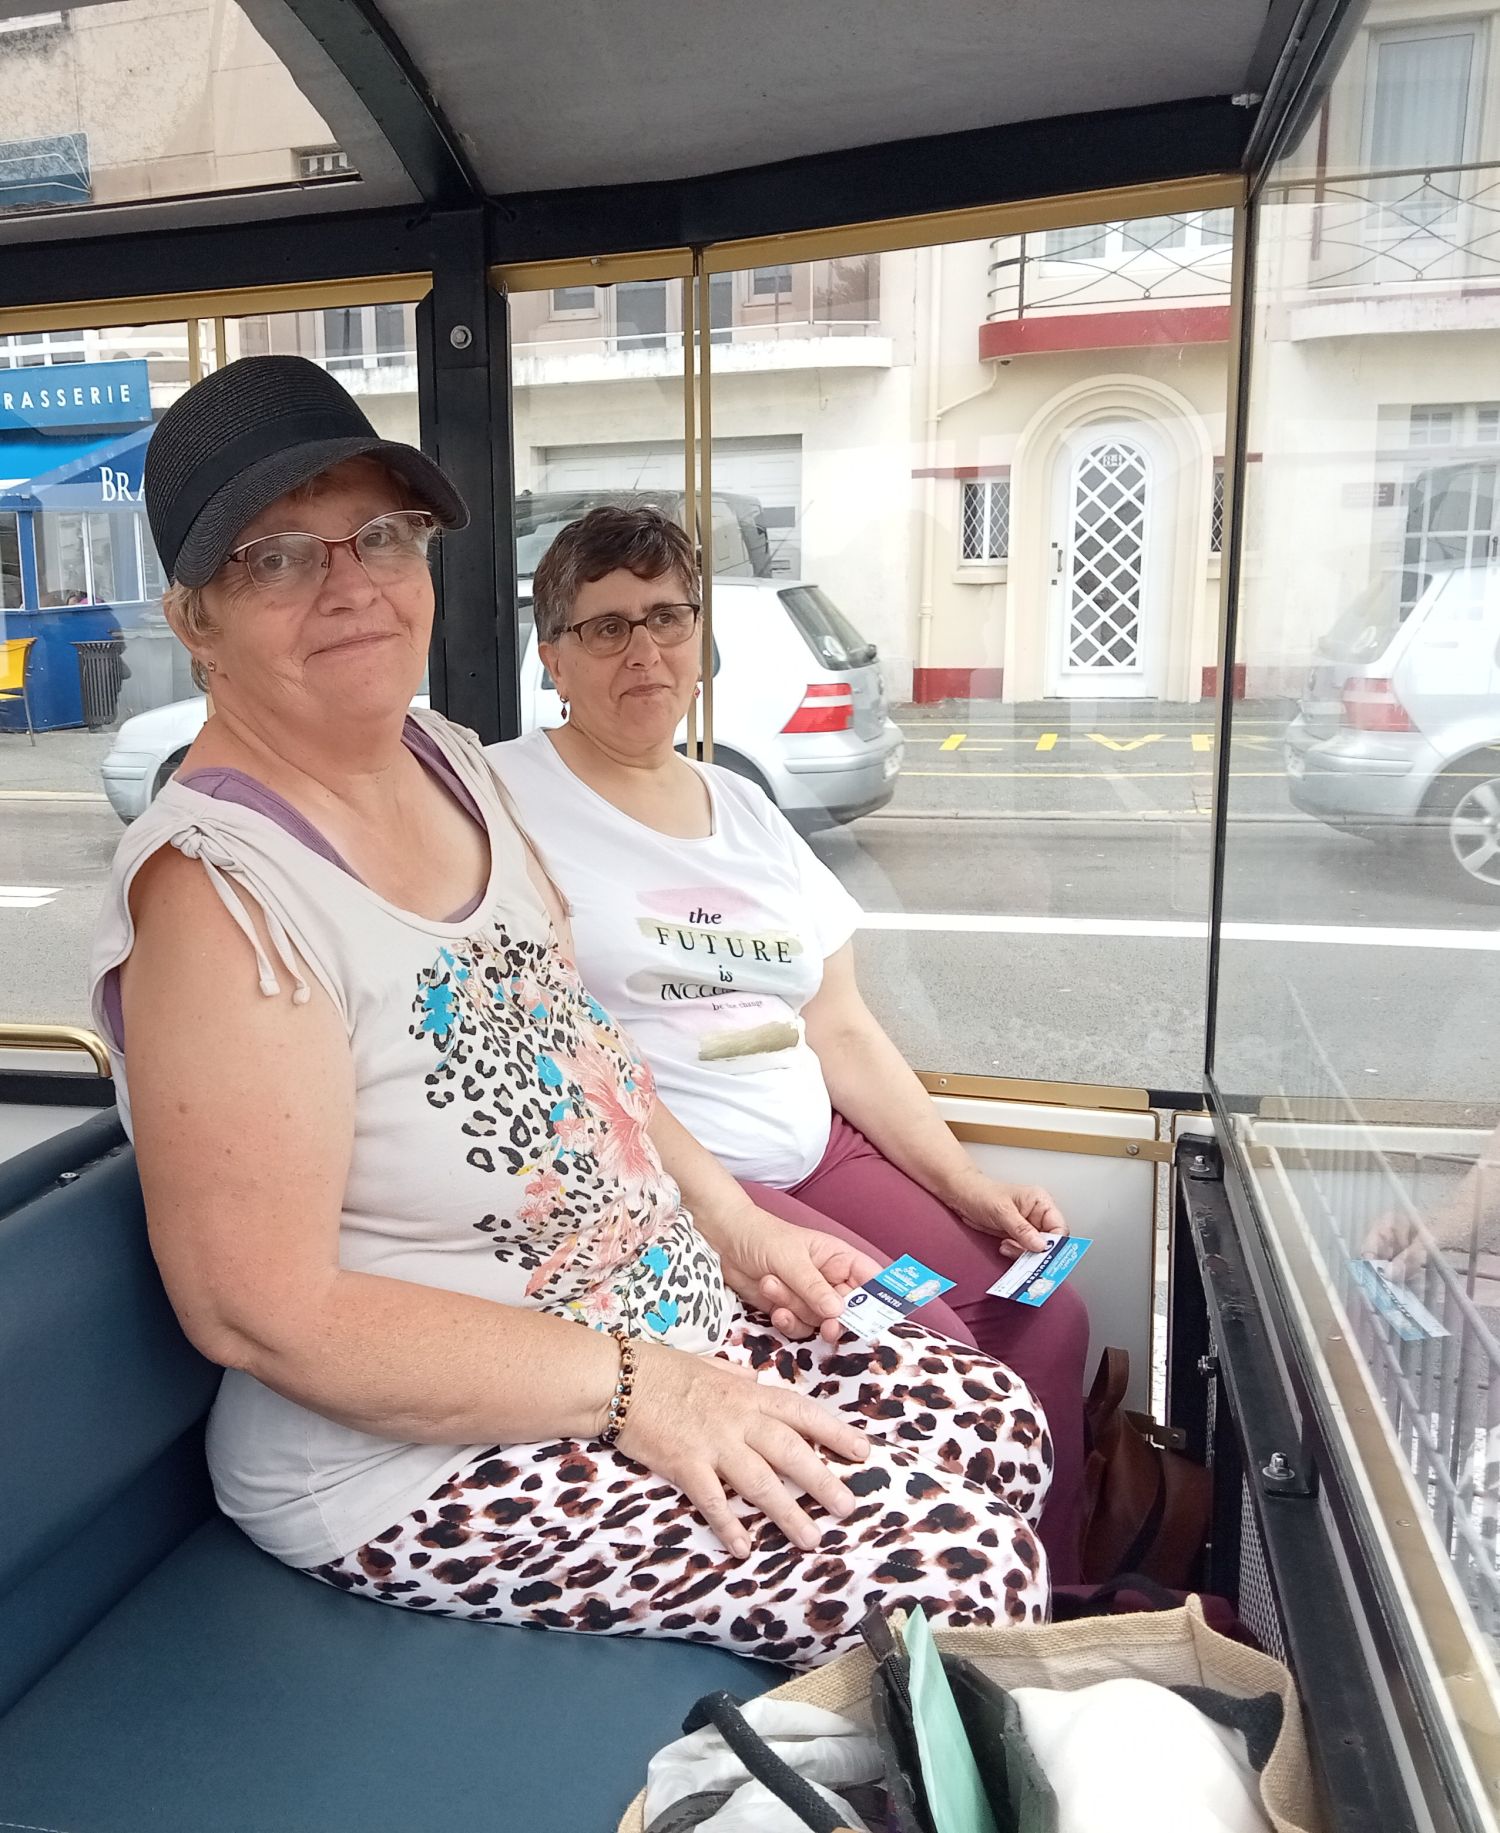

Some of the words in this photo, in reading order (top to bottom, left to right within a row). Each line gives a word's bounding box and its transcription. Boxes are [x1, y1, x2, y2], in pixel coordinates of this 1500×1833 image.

[3, 384, 131, 410] RASSERIE
[688, 907, 722, 925] the
[654, 926, 793, 964] FUTURE
[718, 965, 733, 983] is
[876, 1291, 903, 1309] ADULTES
